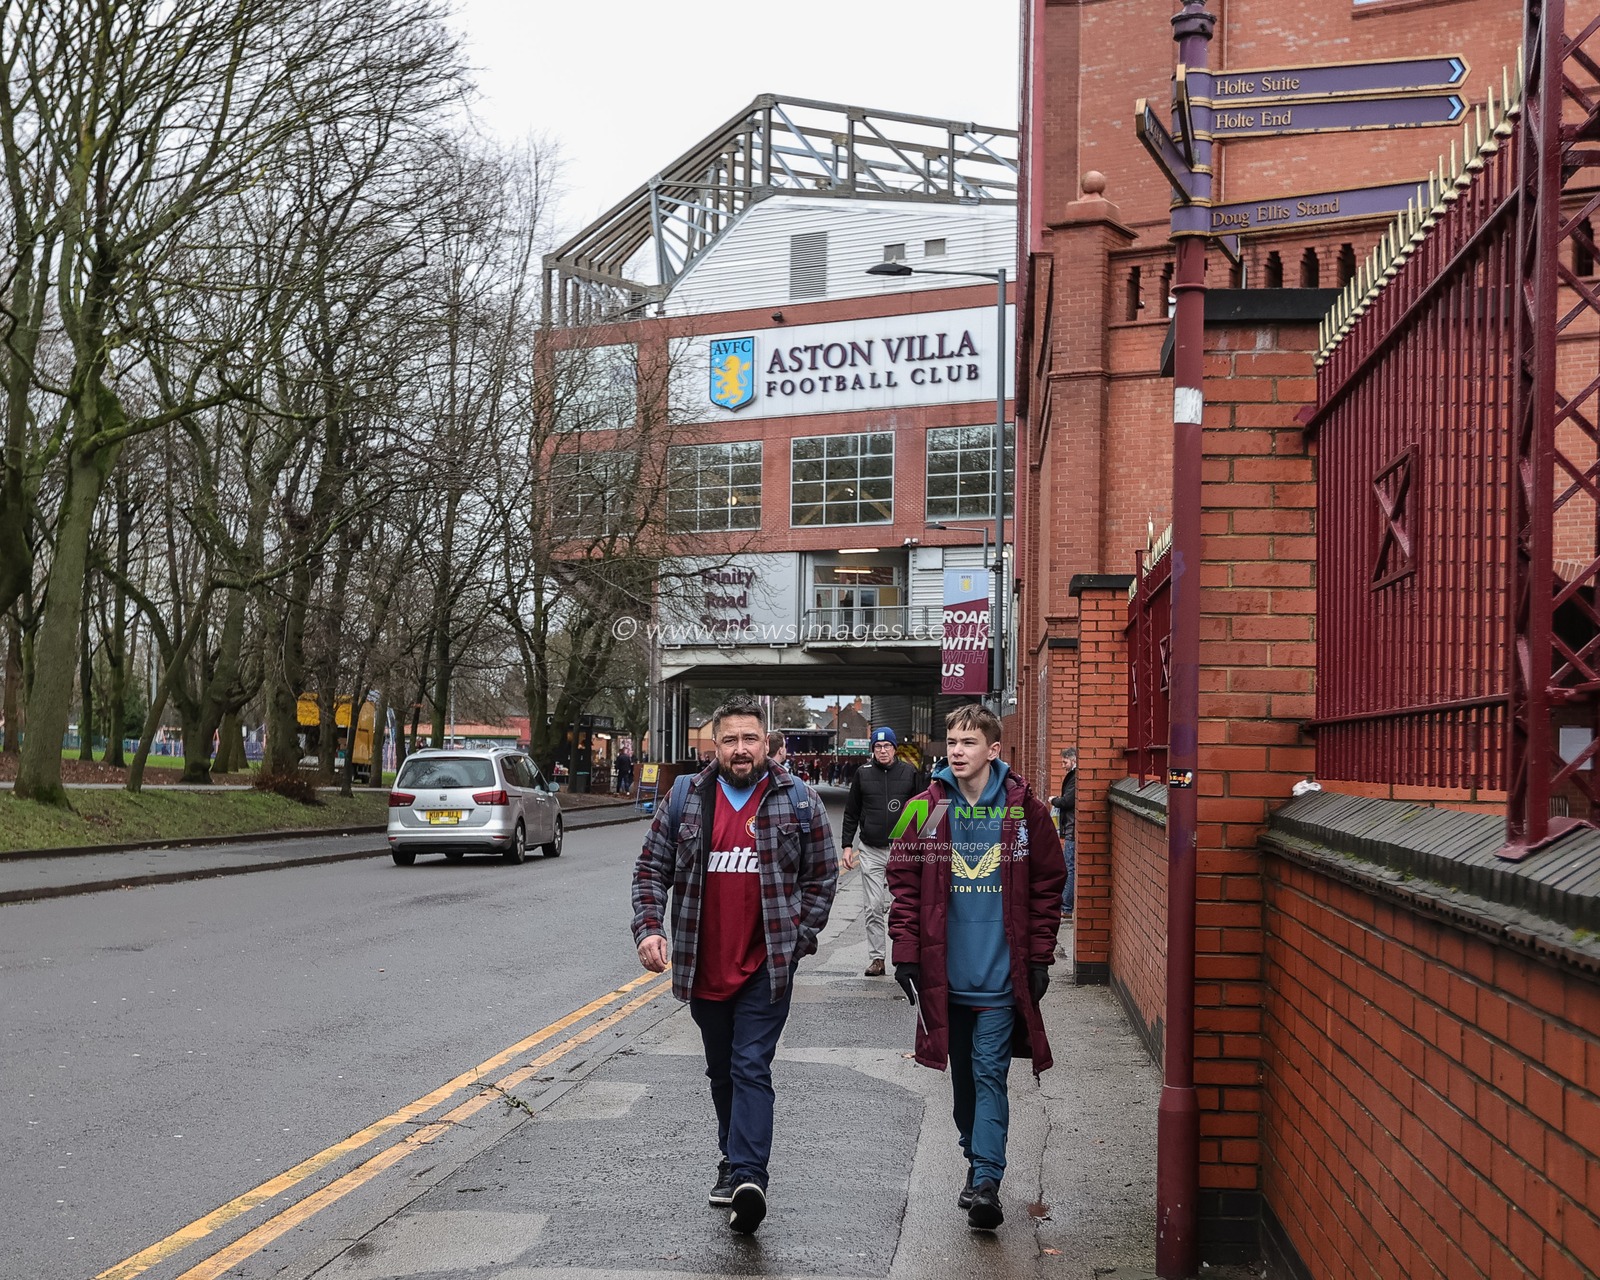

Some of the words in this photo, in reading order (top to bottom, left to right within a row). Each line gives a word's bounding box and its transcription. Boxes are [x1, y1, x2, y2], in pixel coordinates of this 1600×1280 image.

[1215, 77, 1255, 95] Holte
[1260, 74, 1300, 92] Suite
[1215, 112, 1254, 130] Holte
[1260, 109, 1292, 127] End
[1211, 209, 1251, 229] Doug
[1256, 205, 1290, 222] Ellis
[1296, 198, 1340, 218] Stand
[713, 339, 751, 356] AVFC
[766, 340, 874, 374] ASTON
[881, 330, 979, 364] VILLA
[765, 371, 898, 397] FOOTBALL
[910, 363, 980, 386] CLUB
[701, 568, 754, 589] Trinity
[704, 591, 748, 609] Road
[943, 610, 989, 624] ROAR
[942, 637, 986, 651] WITH
[941, 651, 987, 664] WITH
[941, 664, 965, 677] US
[941, 677, 965, 691] US
